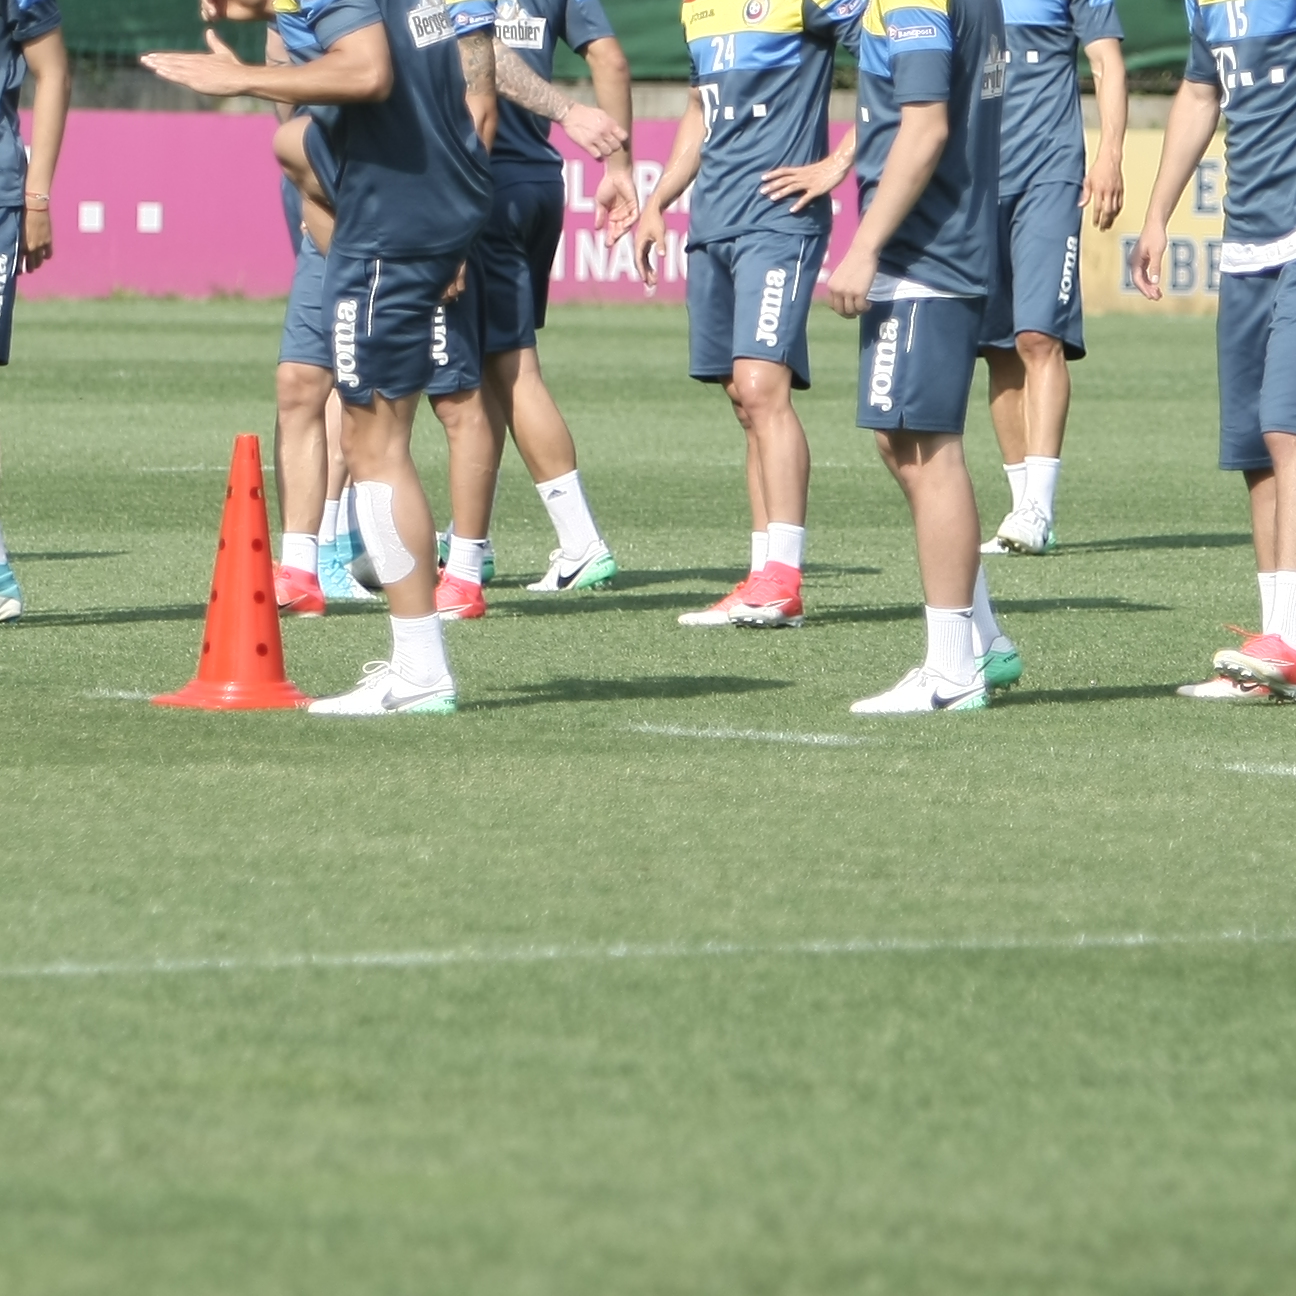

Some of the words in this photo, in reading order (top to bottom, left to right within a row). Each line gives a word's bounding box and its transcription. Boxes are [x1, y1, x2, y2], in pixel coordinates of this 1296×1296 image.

[710, 33, 735, 72] 24
[1226, 0, 1248, 38] 15
[334, 299, 360, 388] Joma
[756, 268, 787, 348] Joma
[870, 317, 900, 413] Joma
